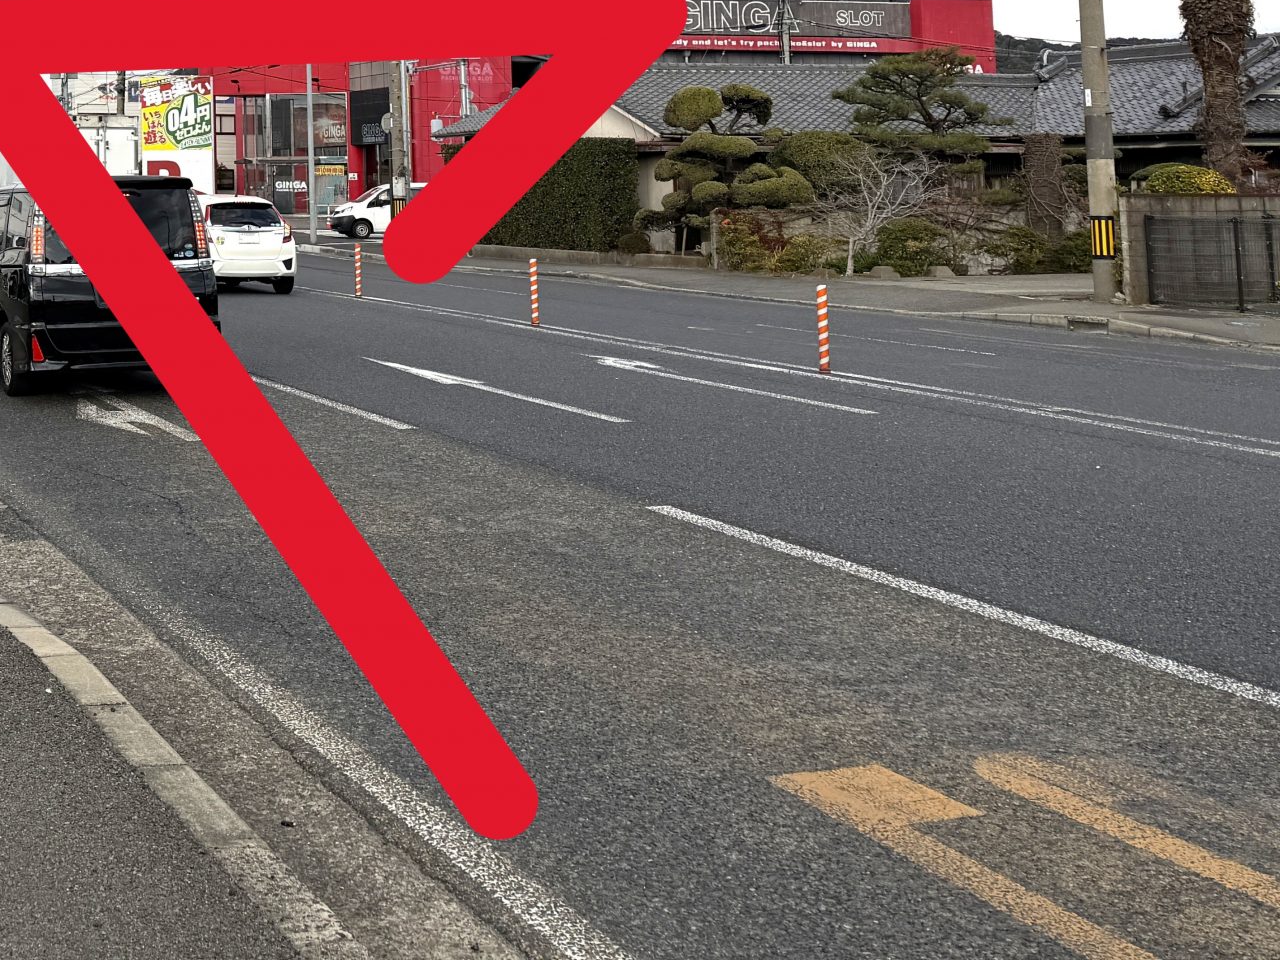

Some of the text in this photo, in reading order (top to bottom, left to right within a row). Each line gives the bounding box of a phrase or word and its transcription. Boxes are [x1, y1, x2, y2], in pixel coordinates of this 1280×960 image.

[836, 9, 885, 26] SLOT
[740, 39, 754, 48] try
[167, 93, 211, 132] 0.4円
[175, 122, 211, 141] ゼロよん
[323, 124, 346, 138] GINGA
[275, 180, 308, 189] GINGA
